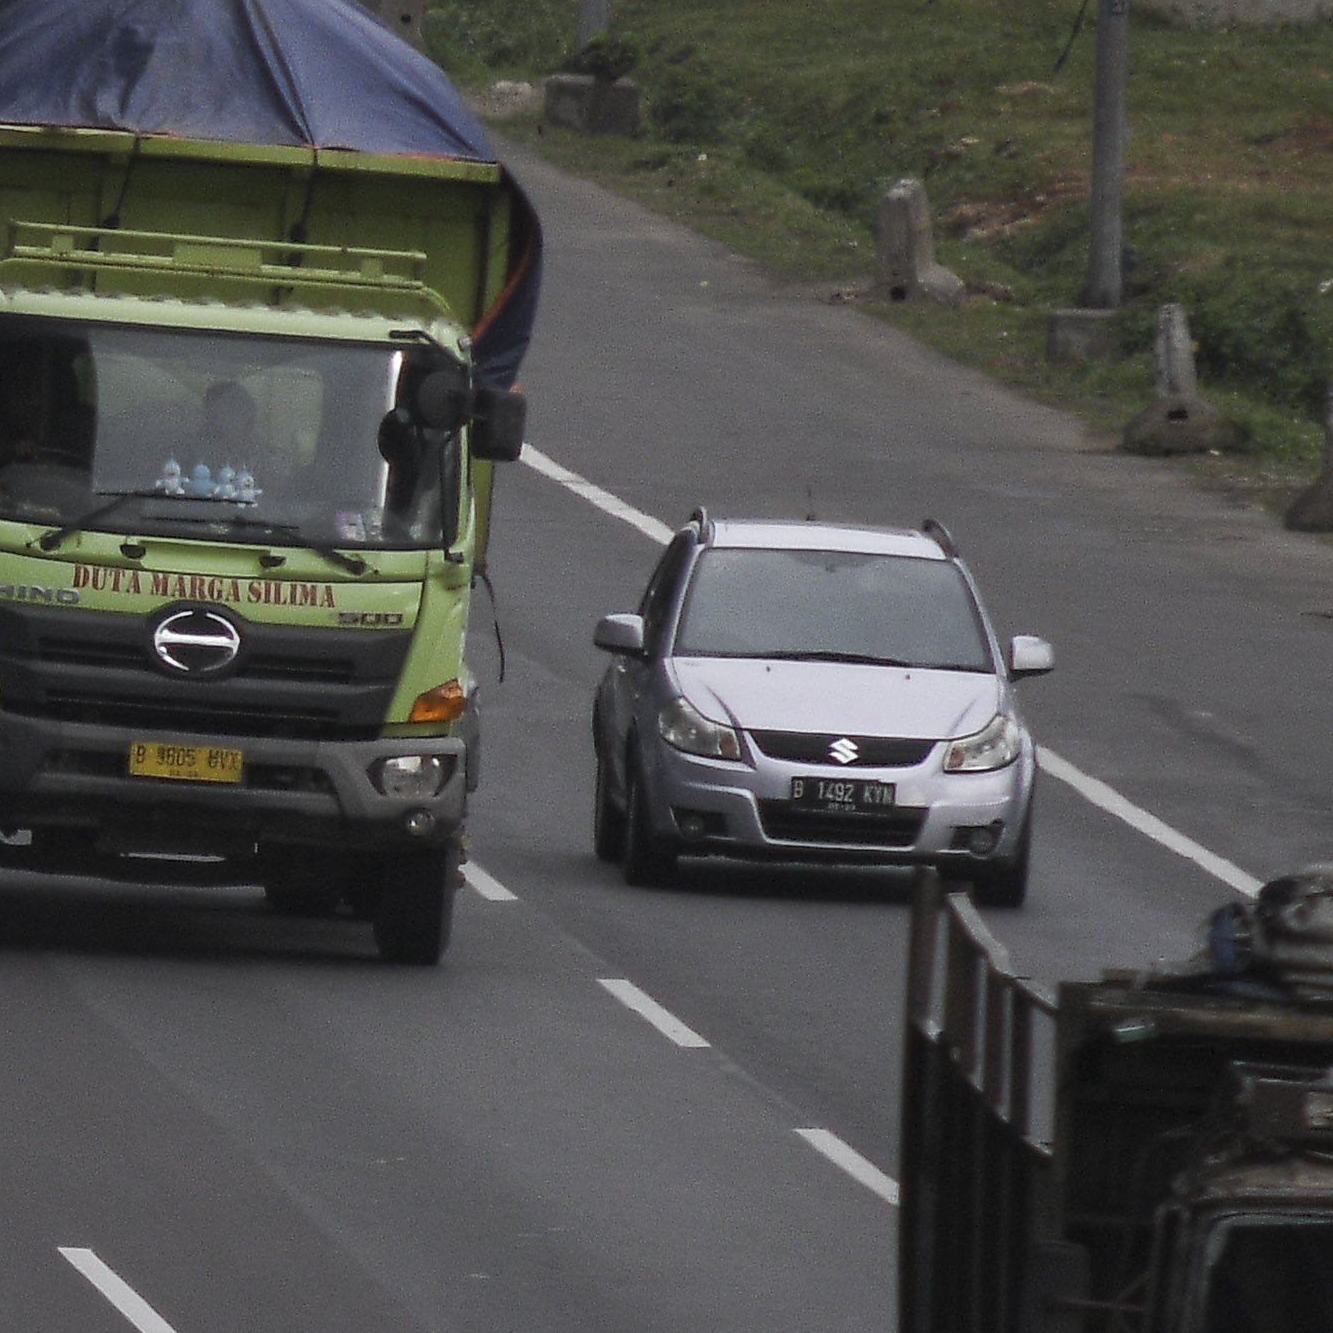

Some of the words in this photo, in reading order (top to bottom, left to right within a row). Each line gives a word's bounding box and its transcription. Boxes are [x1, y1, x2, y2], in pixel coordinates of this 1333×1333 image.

[72, 563, 142, 594] DUTA
[150, 570, 241, 603] MARGA
[247, 580, 336, 609] SILIMA
[793, 779, 804, 799] B
[818, 781, 854, 803] 1492
